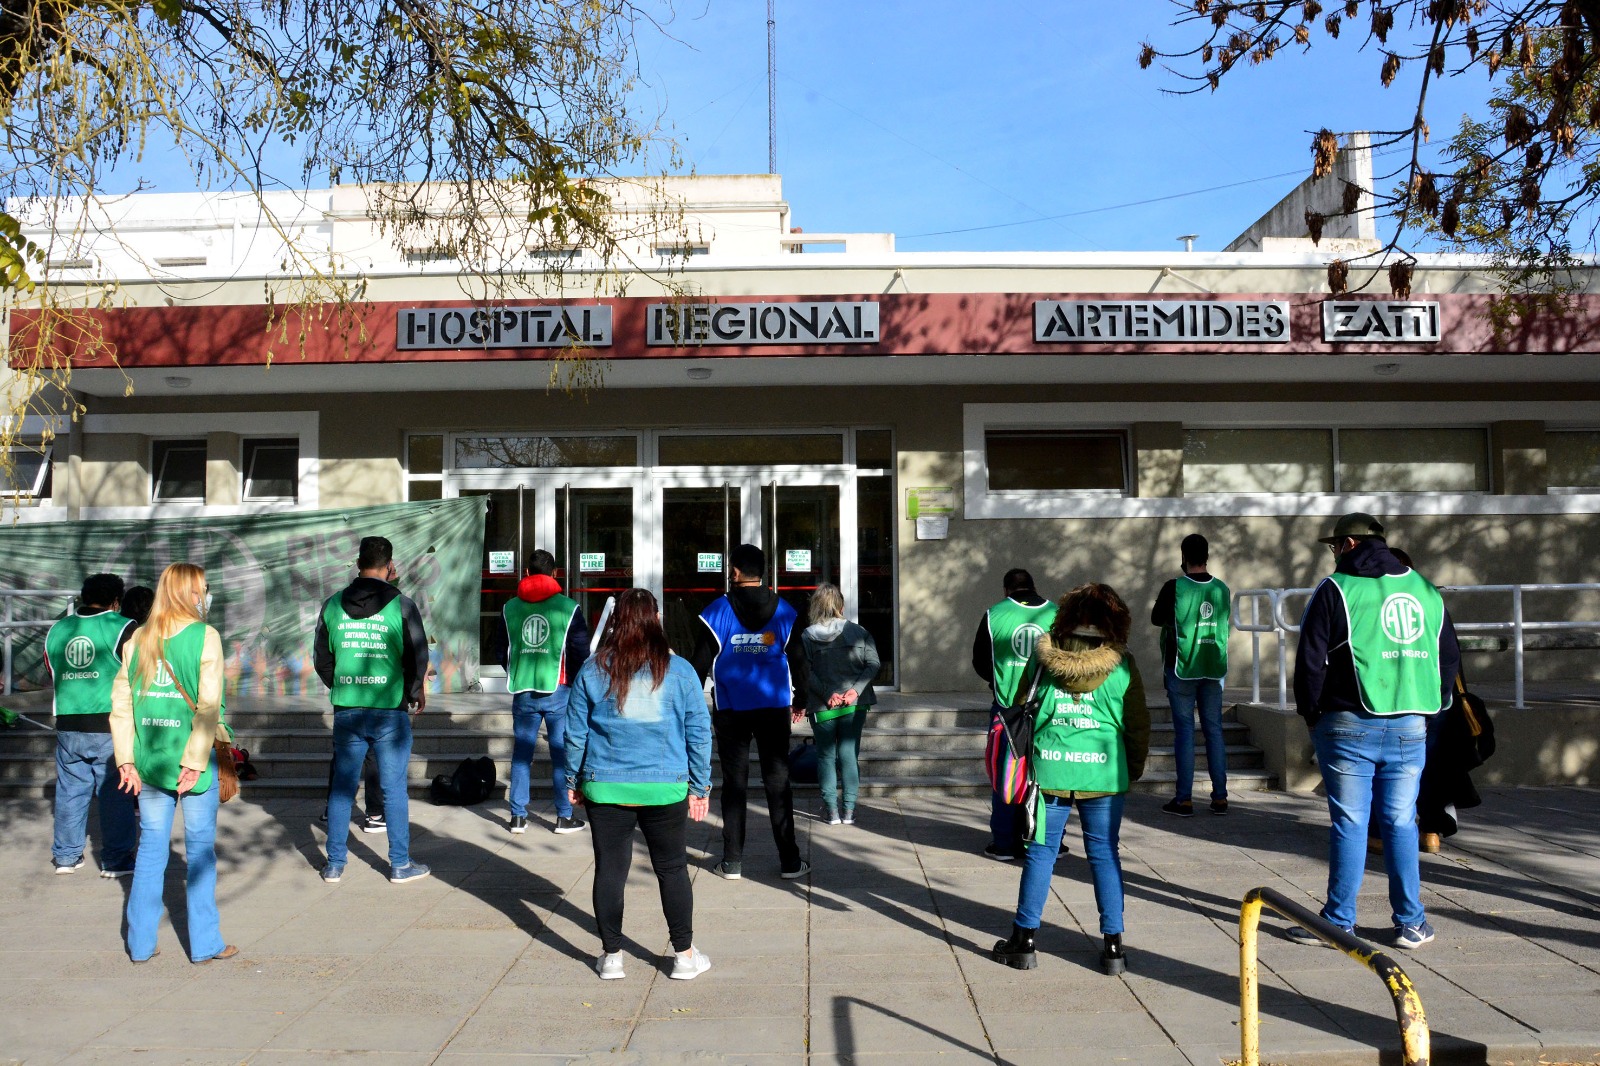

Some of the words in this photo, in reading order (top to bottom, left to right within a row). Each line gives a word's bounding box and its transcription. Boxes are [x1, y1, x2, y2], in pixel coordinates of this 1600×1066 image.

[407, 309, 604, 345] HOSPITAL
[654, 305, 874, 341] REGIONAL
[1042, 303, 1285, 339] ARTEMIDES
[1333, 305, 1437, 338] ZATTI
[1385, 597, 1421, 641] ATE
[523, 616, 547, 645] ATE
[370, 632, 382, 640] QUE
[360, 642, 386, 650] CALLADOS
[67, 637, 93, 667] ATE
[1382, 650, 1400, 659] RIO
[74, 671, 100, 679] NEGRO
[340, 676, 352, 684] RIO
[354, 676, 388, 684] NEGRO
[1057, 703, 1092, 715] SERVICIO
[152, 718, 182, 728] NEGRO
[1052, 718, 1068, 726] DEL
[1041, 749, 1062, 761] RIO
[1064, 751, 1108, 764] NEGRO
